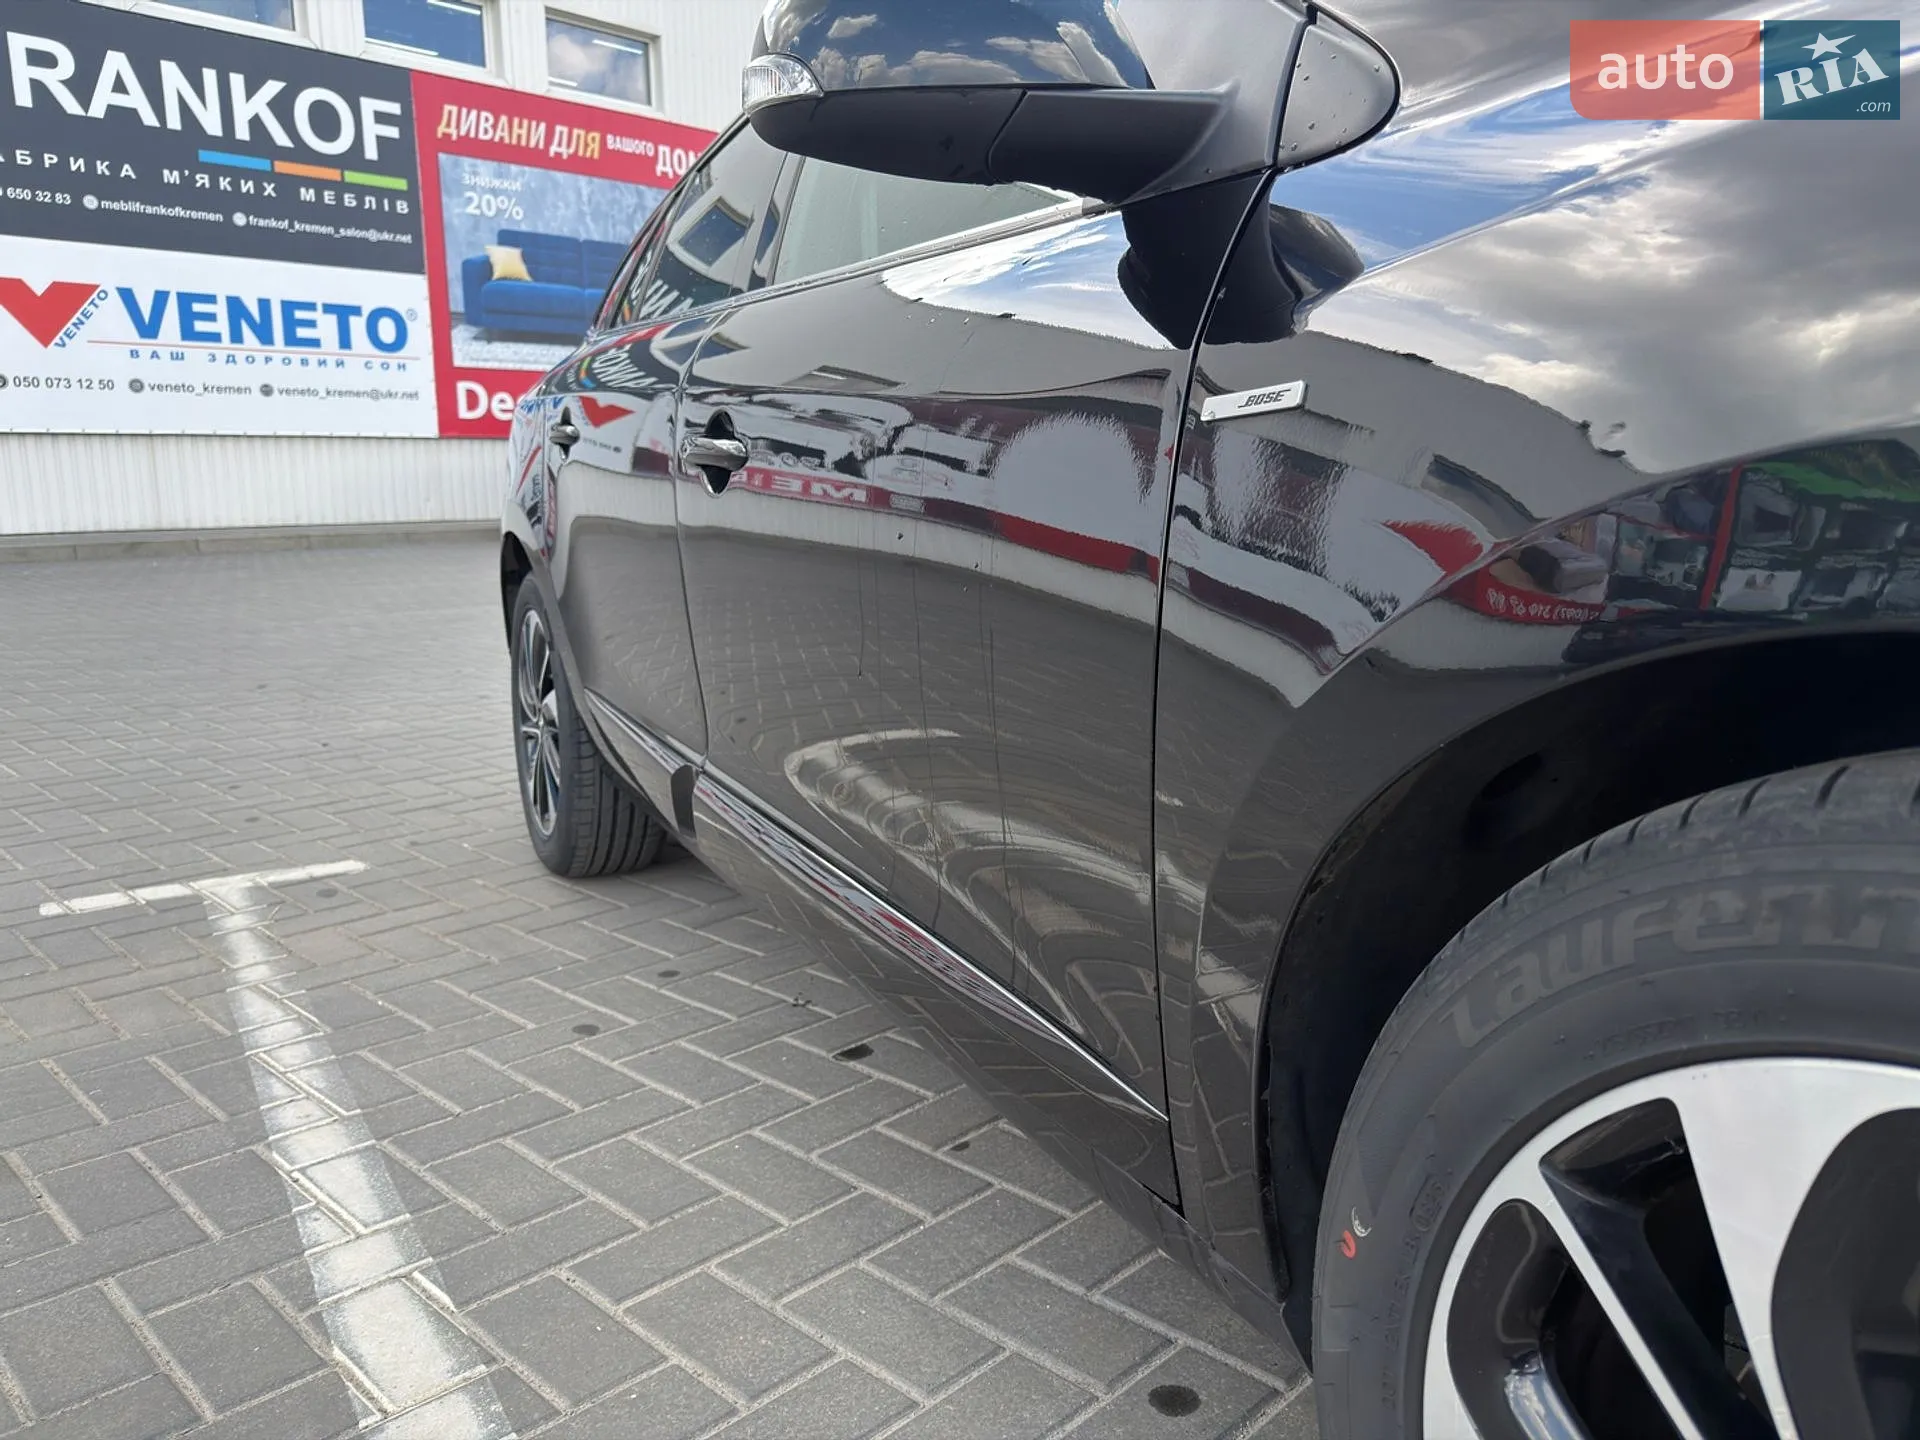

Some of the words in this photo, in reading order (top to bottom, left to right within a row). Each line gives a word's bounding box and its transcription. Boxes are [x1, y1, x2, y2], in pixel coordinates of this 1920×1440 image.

[437, 103, 546, 150] ДИВАНИ
[549, 124, 601, 160] ДЛЯ
[606, 133, 655, 157] ВАШОГО
[6, 186, 32, 201] 650
[35, 190, 52, 203] 32
[54, 191, 72, 205] 83
[299, 186, 410, 215] МЕБЛІВ
[464, 191, 525, 220] 20%
[54, 288, 109, 349] VENETO
[115, 286, 408, 354] VENETO
[130, 348, 185, 361] ВАШ
[364, 360, 407, 371] СОН
[13, 375, 40, 389] 050
[45, 376, 72, 390] 073
[76, 378, 94, 390] 12
[98, 378, 115, 391] 50
[148, 380, 252, 397] veneto_kremen
[277, 387, 420, 401] veneto_kremen@ukr.net
[1238, 389, 1291, 408] BOSE
